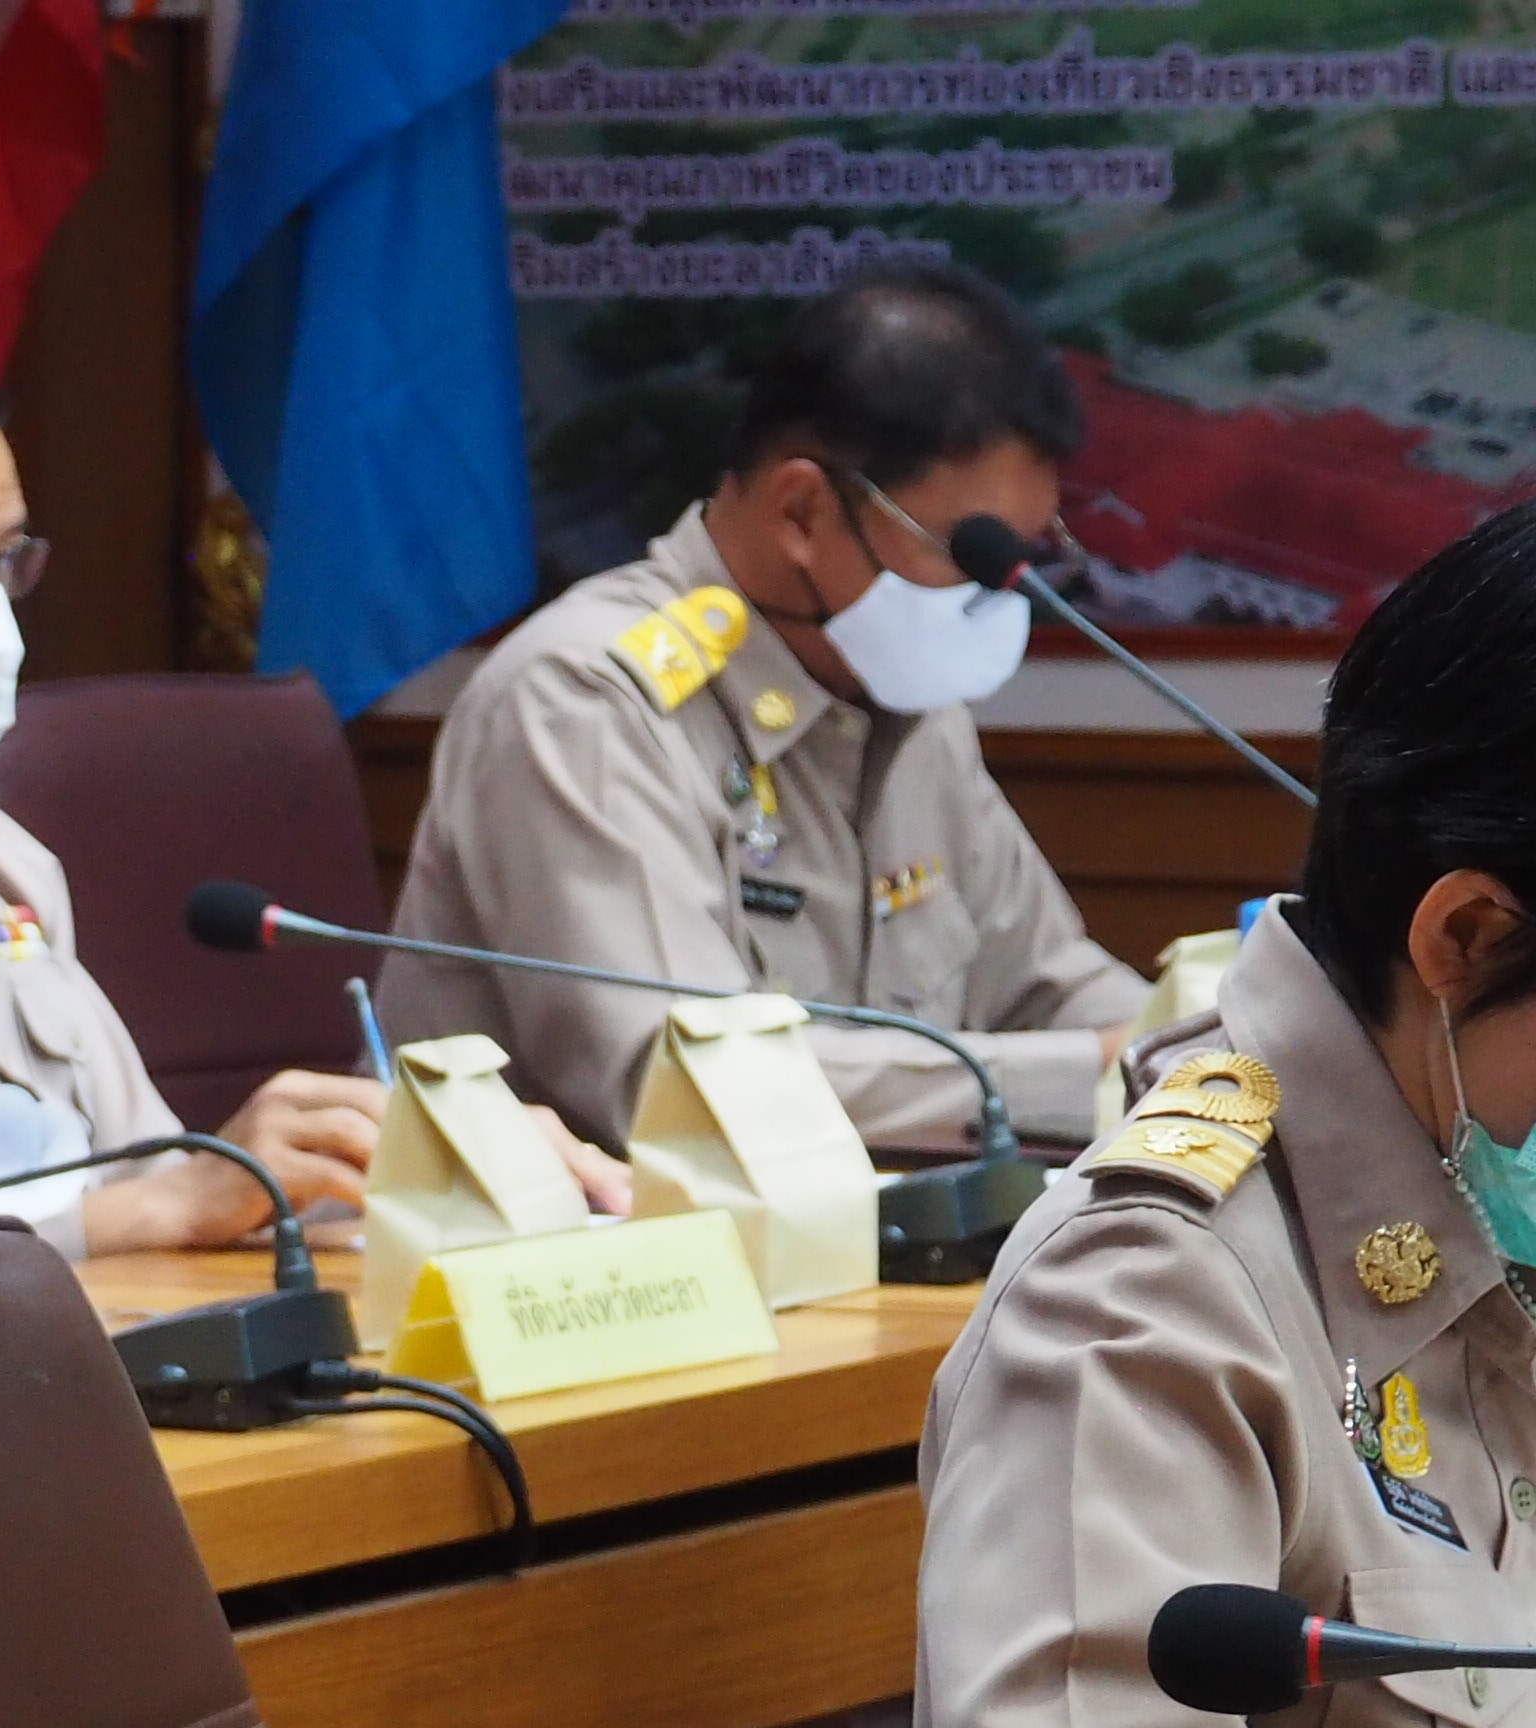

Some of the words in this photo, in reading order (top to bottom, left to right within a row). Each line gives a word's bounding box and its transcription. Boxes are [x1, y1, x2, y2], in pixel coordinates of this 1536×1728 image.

[502, 34, 1439, 113] งเสริมและพัฒนาการท่องเที่ยวเชิงธรรมชาติ
